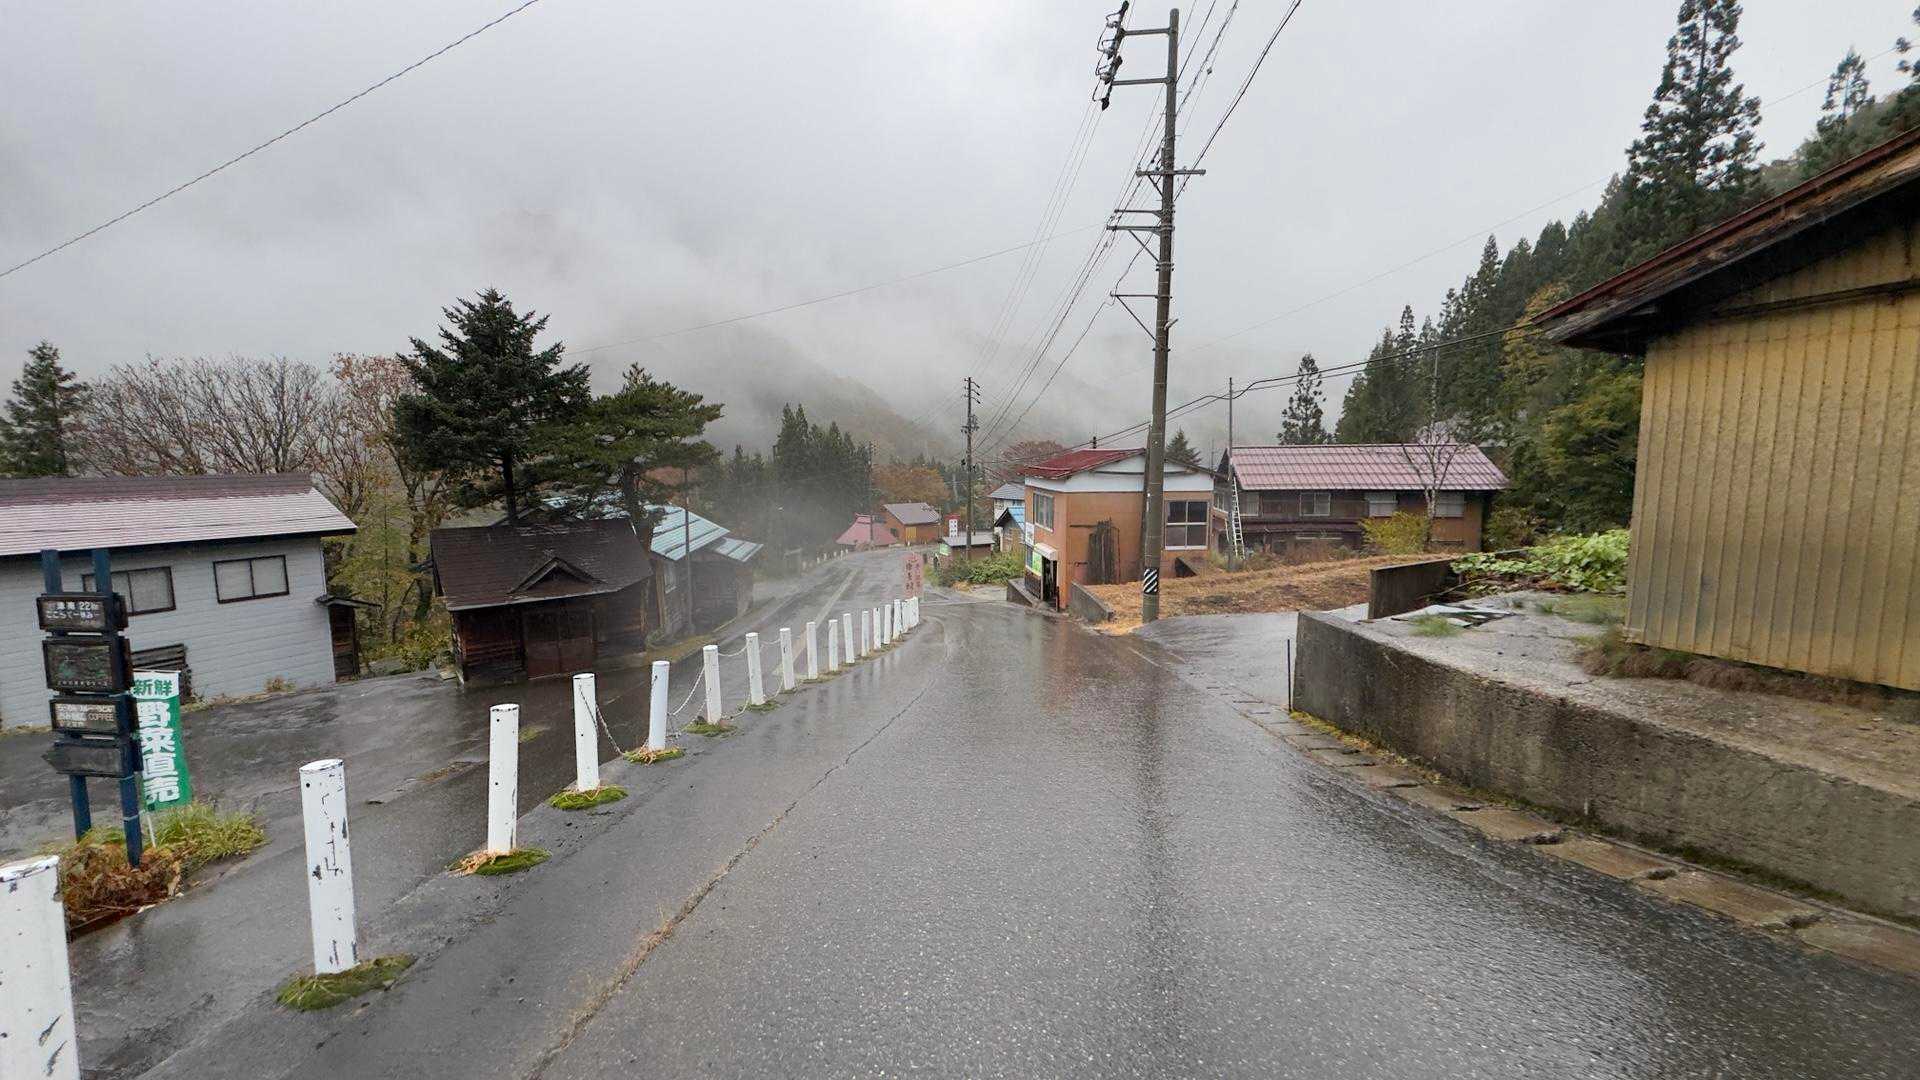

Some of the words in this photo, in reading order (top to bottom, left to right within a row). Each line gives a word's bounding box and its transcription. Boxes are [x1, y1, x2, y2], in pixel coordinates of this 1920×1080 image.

[132, 678, 173, 697] 新鮮
[136, 701, 180, 803] 野菜直売
